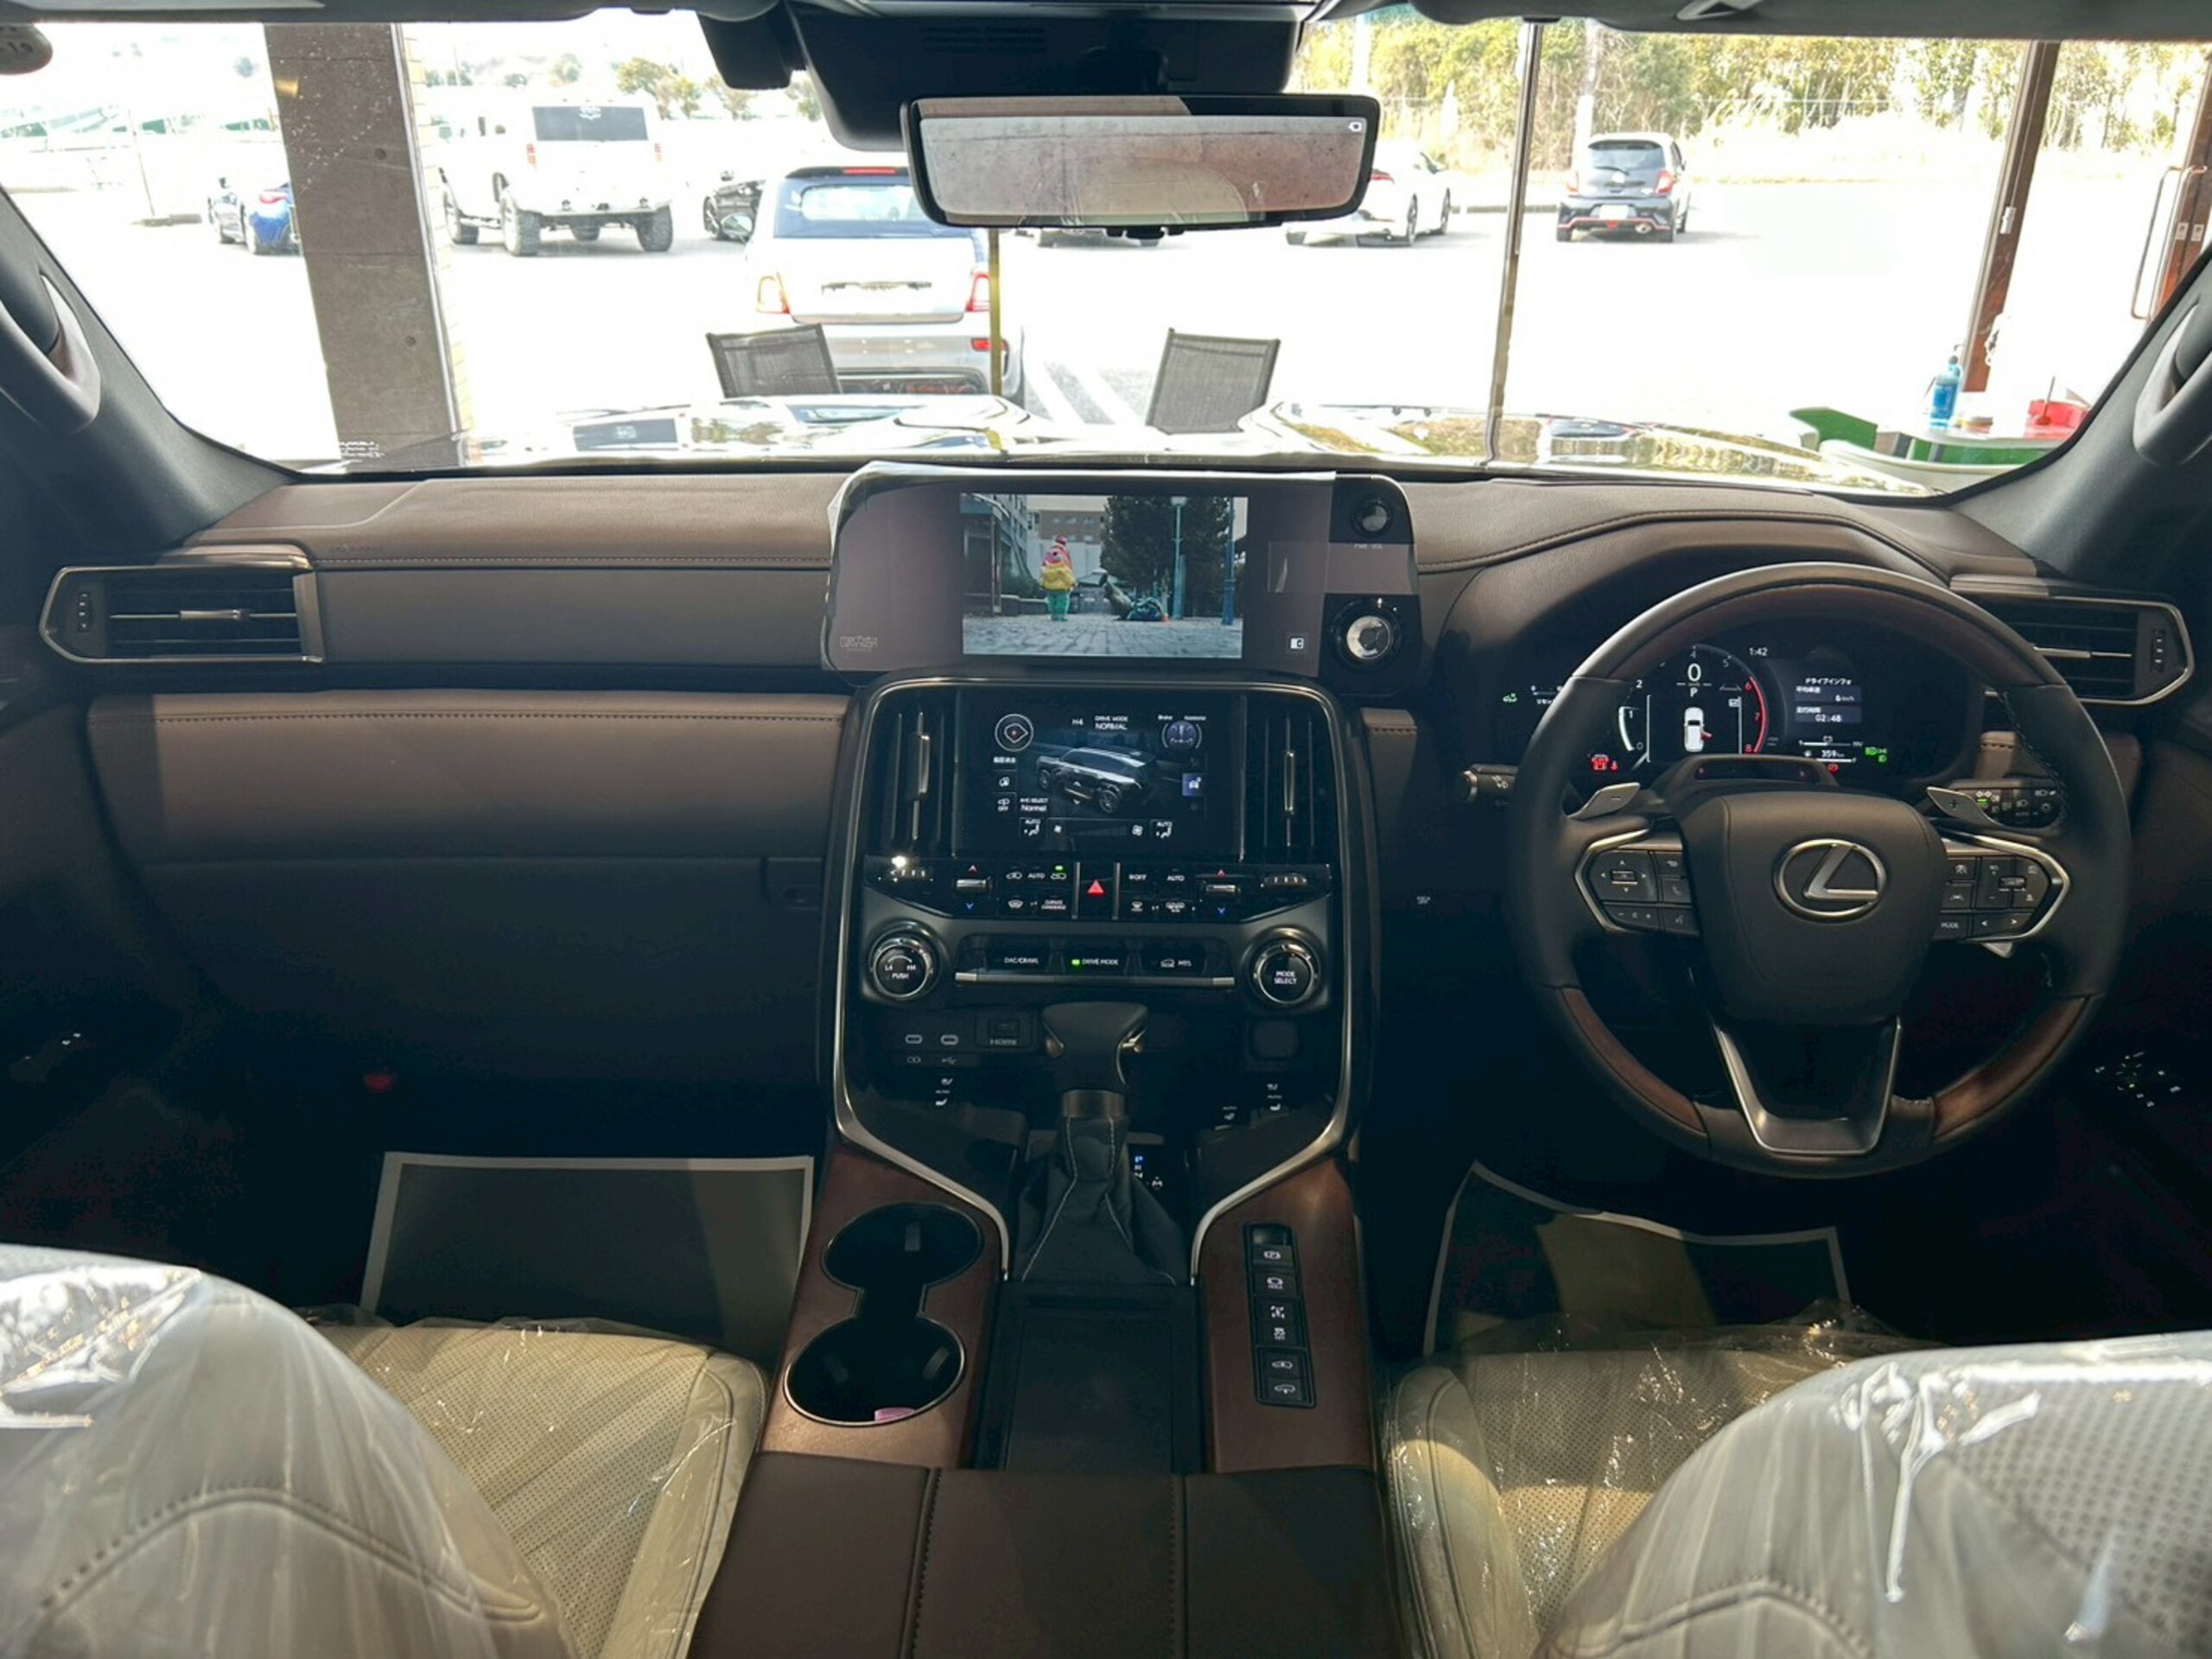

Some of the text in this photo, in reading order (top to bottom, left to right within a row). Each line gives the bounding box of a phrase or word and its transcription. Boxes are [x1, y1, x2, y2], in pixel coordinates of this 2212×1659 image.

[1749, 648, 1769, 657] 1:42
[1687, 662, 1702, 683] 0
[1636, 679, 1643, 689] 2
[1689, 688, 1698, 698] P
[1020, 804, 1048, 812] Normal
[1940, 921, 1960, 930] MODE
[1274, 976, 1298, 985] SELECT
[1134, 1155, 1144, 1164] P
